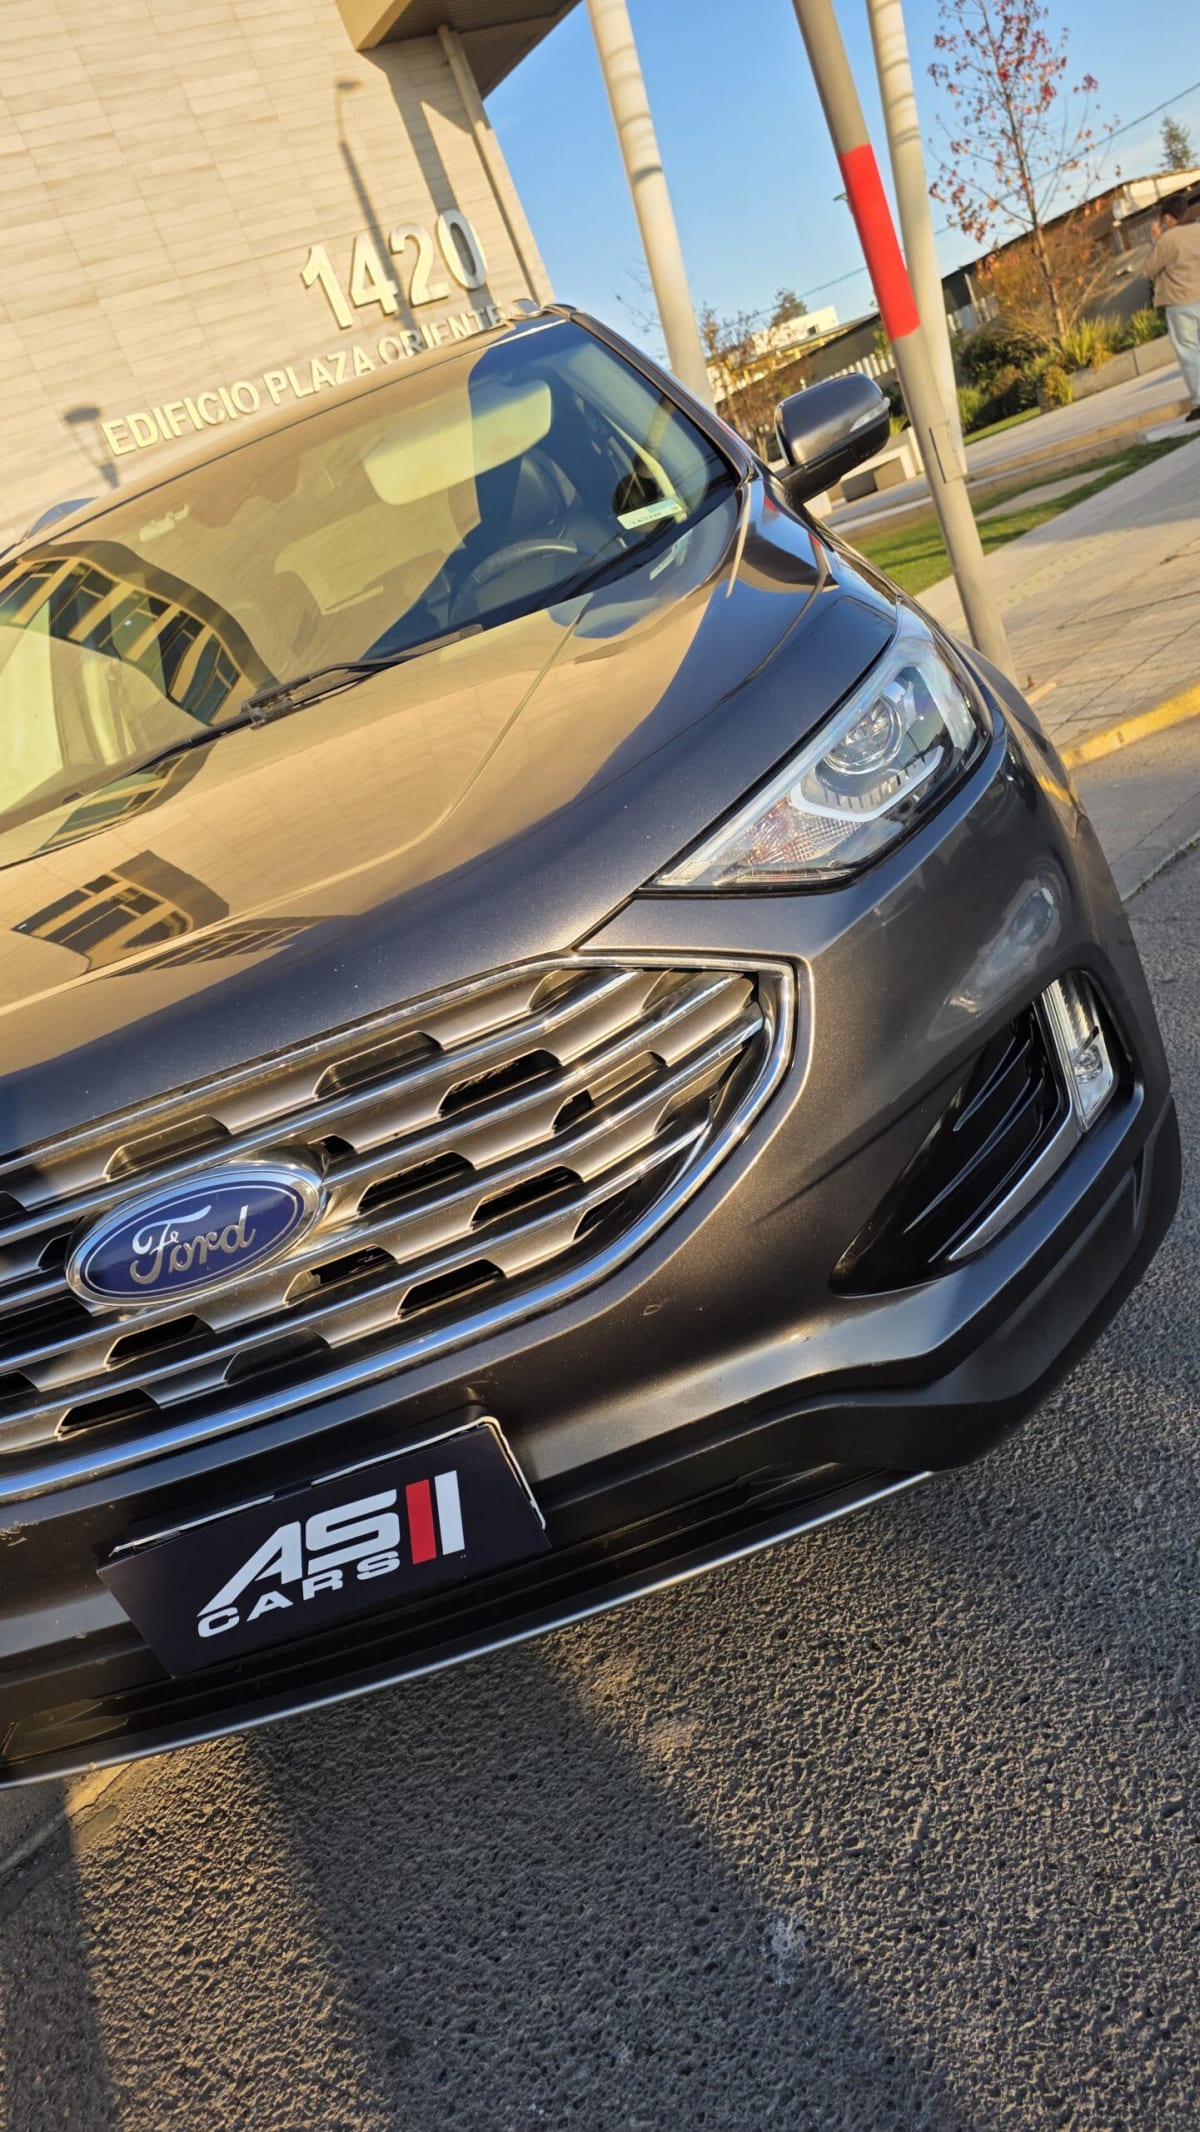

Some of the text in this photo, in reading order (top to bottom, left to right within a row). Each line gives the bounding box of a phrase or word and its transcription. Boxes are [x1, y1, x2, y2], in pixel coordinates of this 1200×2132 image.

[300, 209, 488, 330] 1420
[101, 303, 503, 456] EDIFICIO PLAZA ORIENTE
[129, 1204, 256, 1285] Ford
[197, 1550, 401, 1638] CARS
